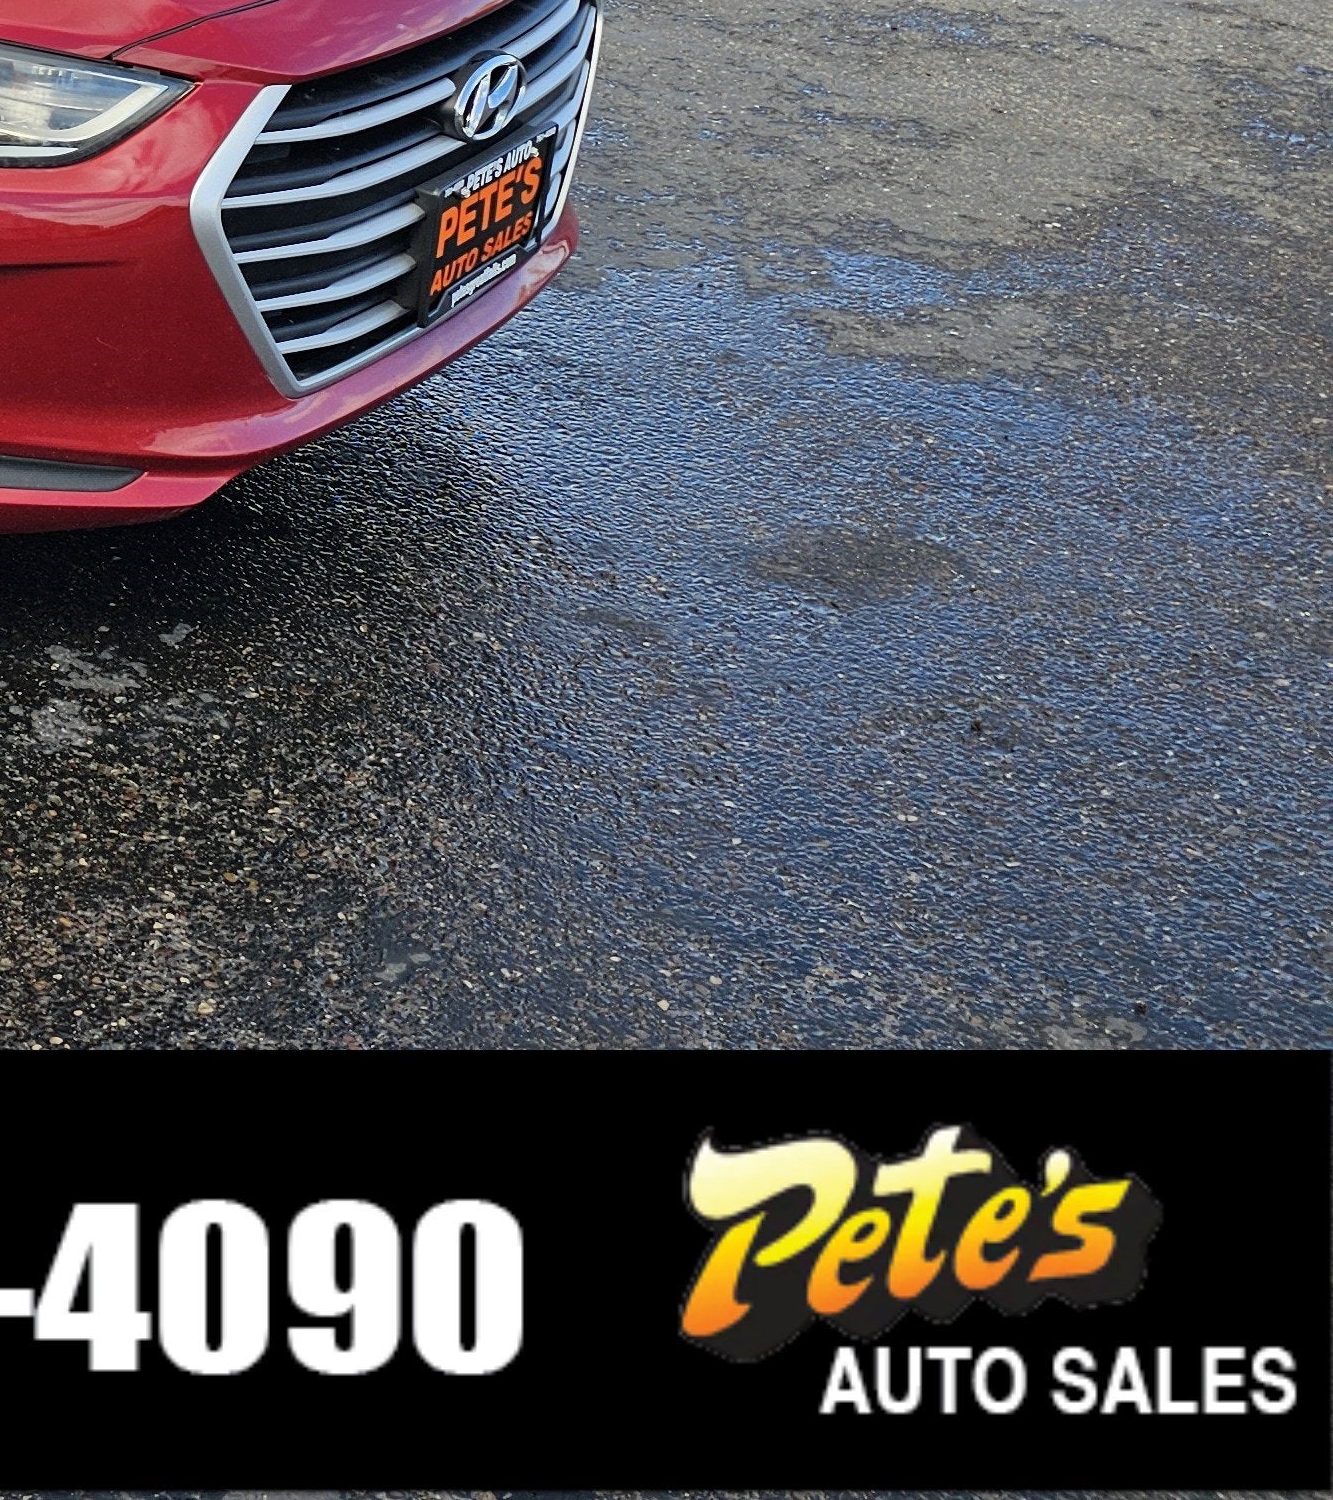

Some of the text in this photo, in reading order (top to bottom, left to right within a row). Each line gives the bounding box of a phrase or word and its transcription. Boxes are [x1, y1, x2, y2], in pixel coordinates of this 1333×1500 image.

[436, 156, 542, 259] PETE'S
[466, 157, 504, 192] PETE'S
[503, 139, 534, 173] AUTO
[429, 247, 479, 297] AUTO
[480, 210, 534, 262] SALES
